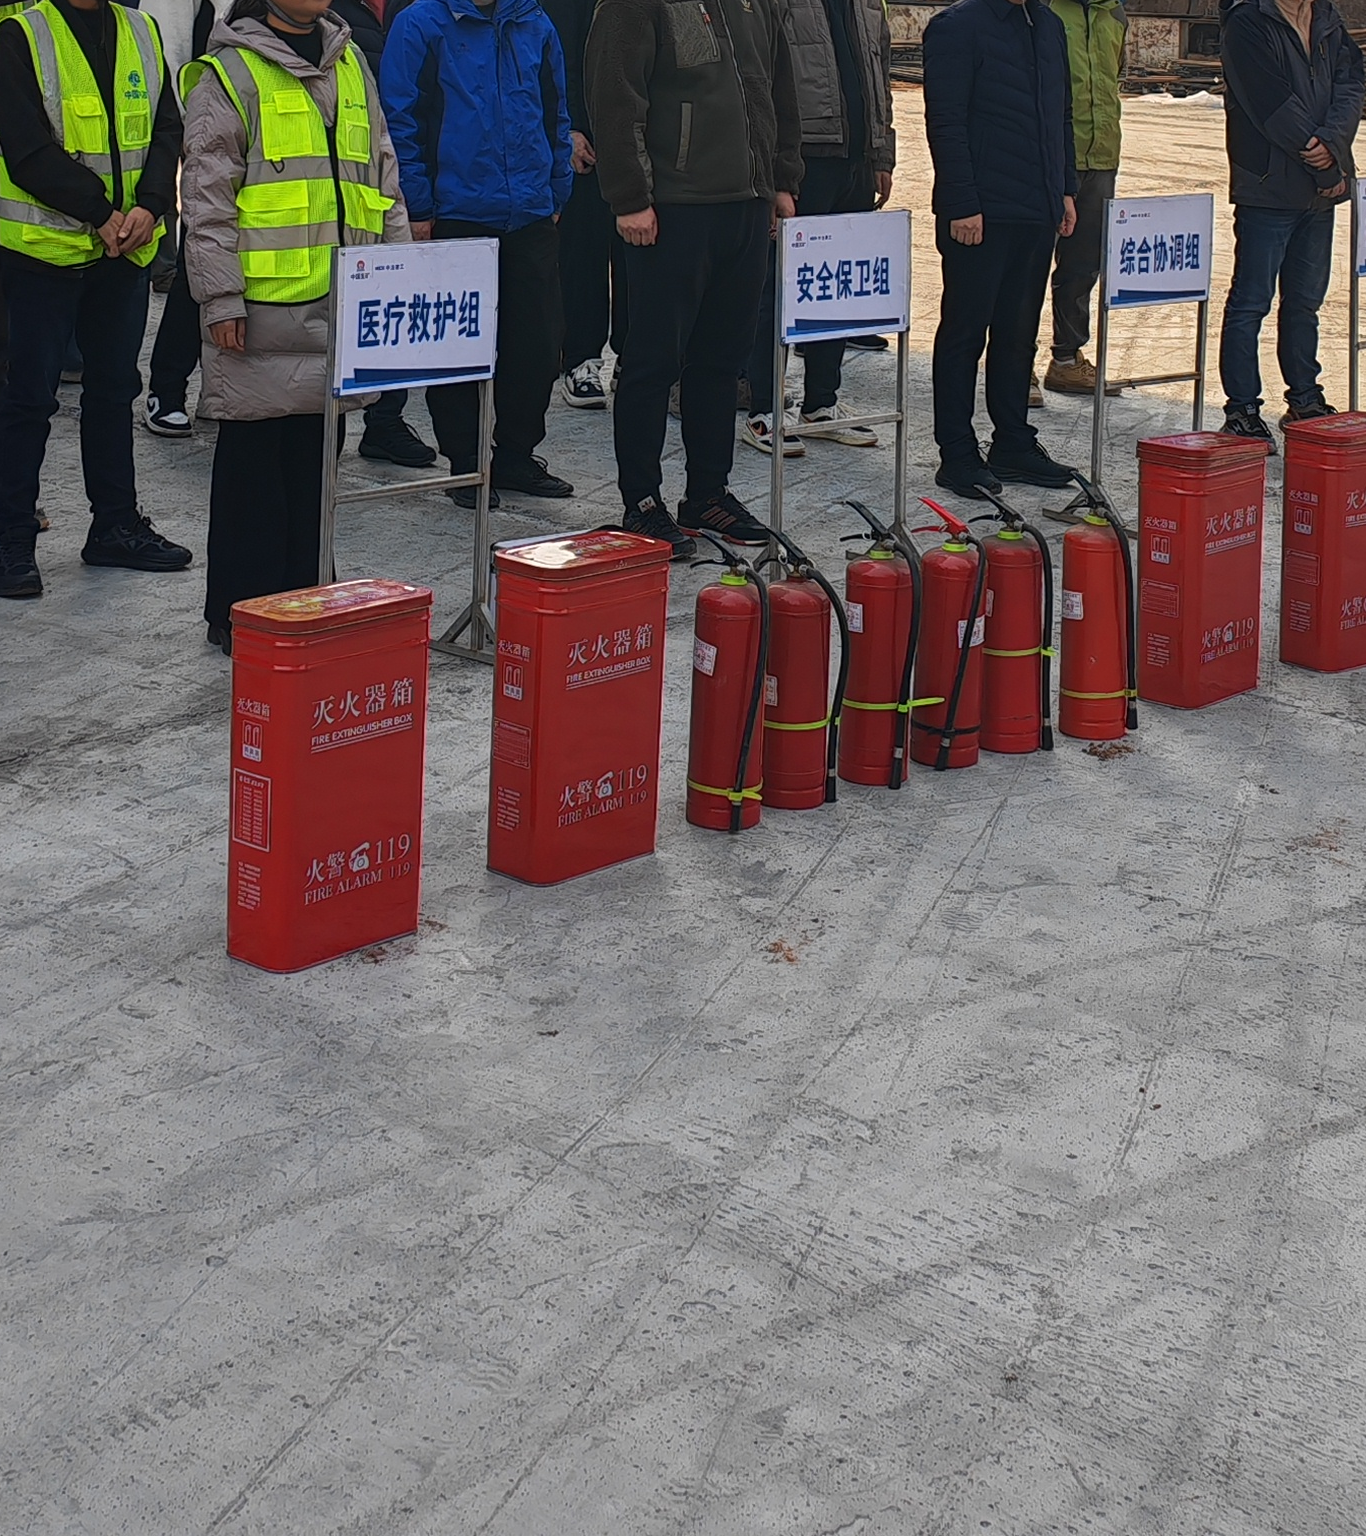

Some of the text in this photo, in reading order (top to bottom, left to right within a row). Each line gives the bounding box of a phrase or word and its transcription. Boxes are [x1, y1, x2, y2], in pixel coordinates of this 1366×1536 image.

[1119, 232, 1200, 276] 综合协调组
[796, 256, 891, 304] 安全保卫组
[357, 290, 481, 348] 医疗救护组
[1204, 504, 1257, 539] 灭火器箱
[566, 623, 653, 669] 灭火器箱
[1235, 616, 1254, 638] 119
[566, 672, 583, 684] FIRE
[311, 677, 414, 730] 灭火器箱
[311, 712, 413, 746] FIRE EXTINGUISHER BOX
[558, 779, 593, 813] 火警
[617, 764, 648, 792] 119
[558, 789, 647, 828] FIRE ALARM 119
[303, 850, 346, 890] 火警
[375, 832, 412, 865] 119
[304, 861, 411, 906] FIRE ALARM 119
